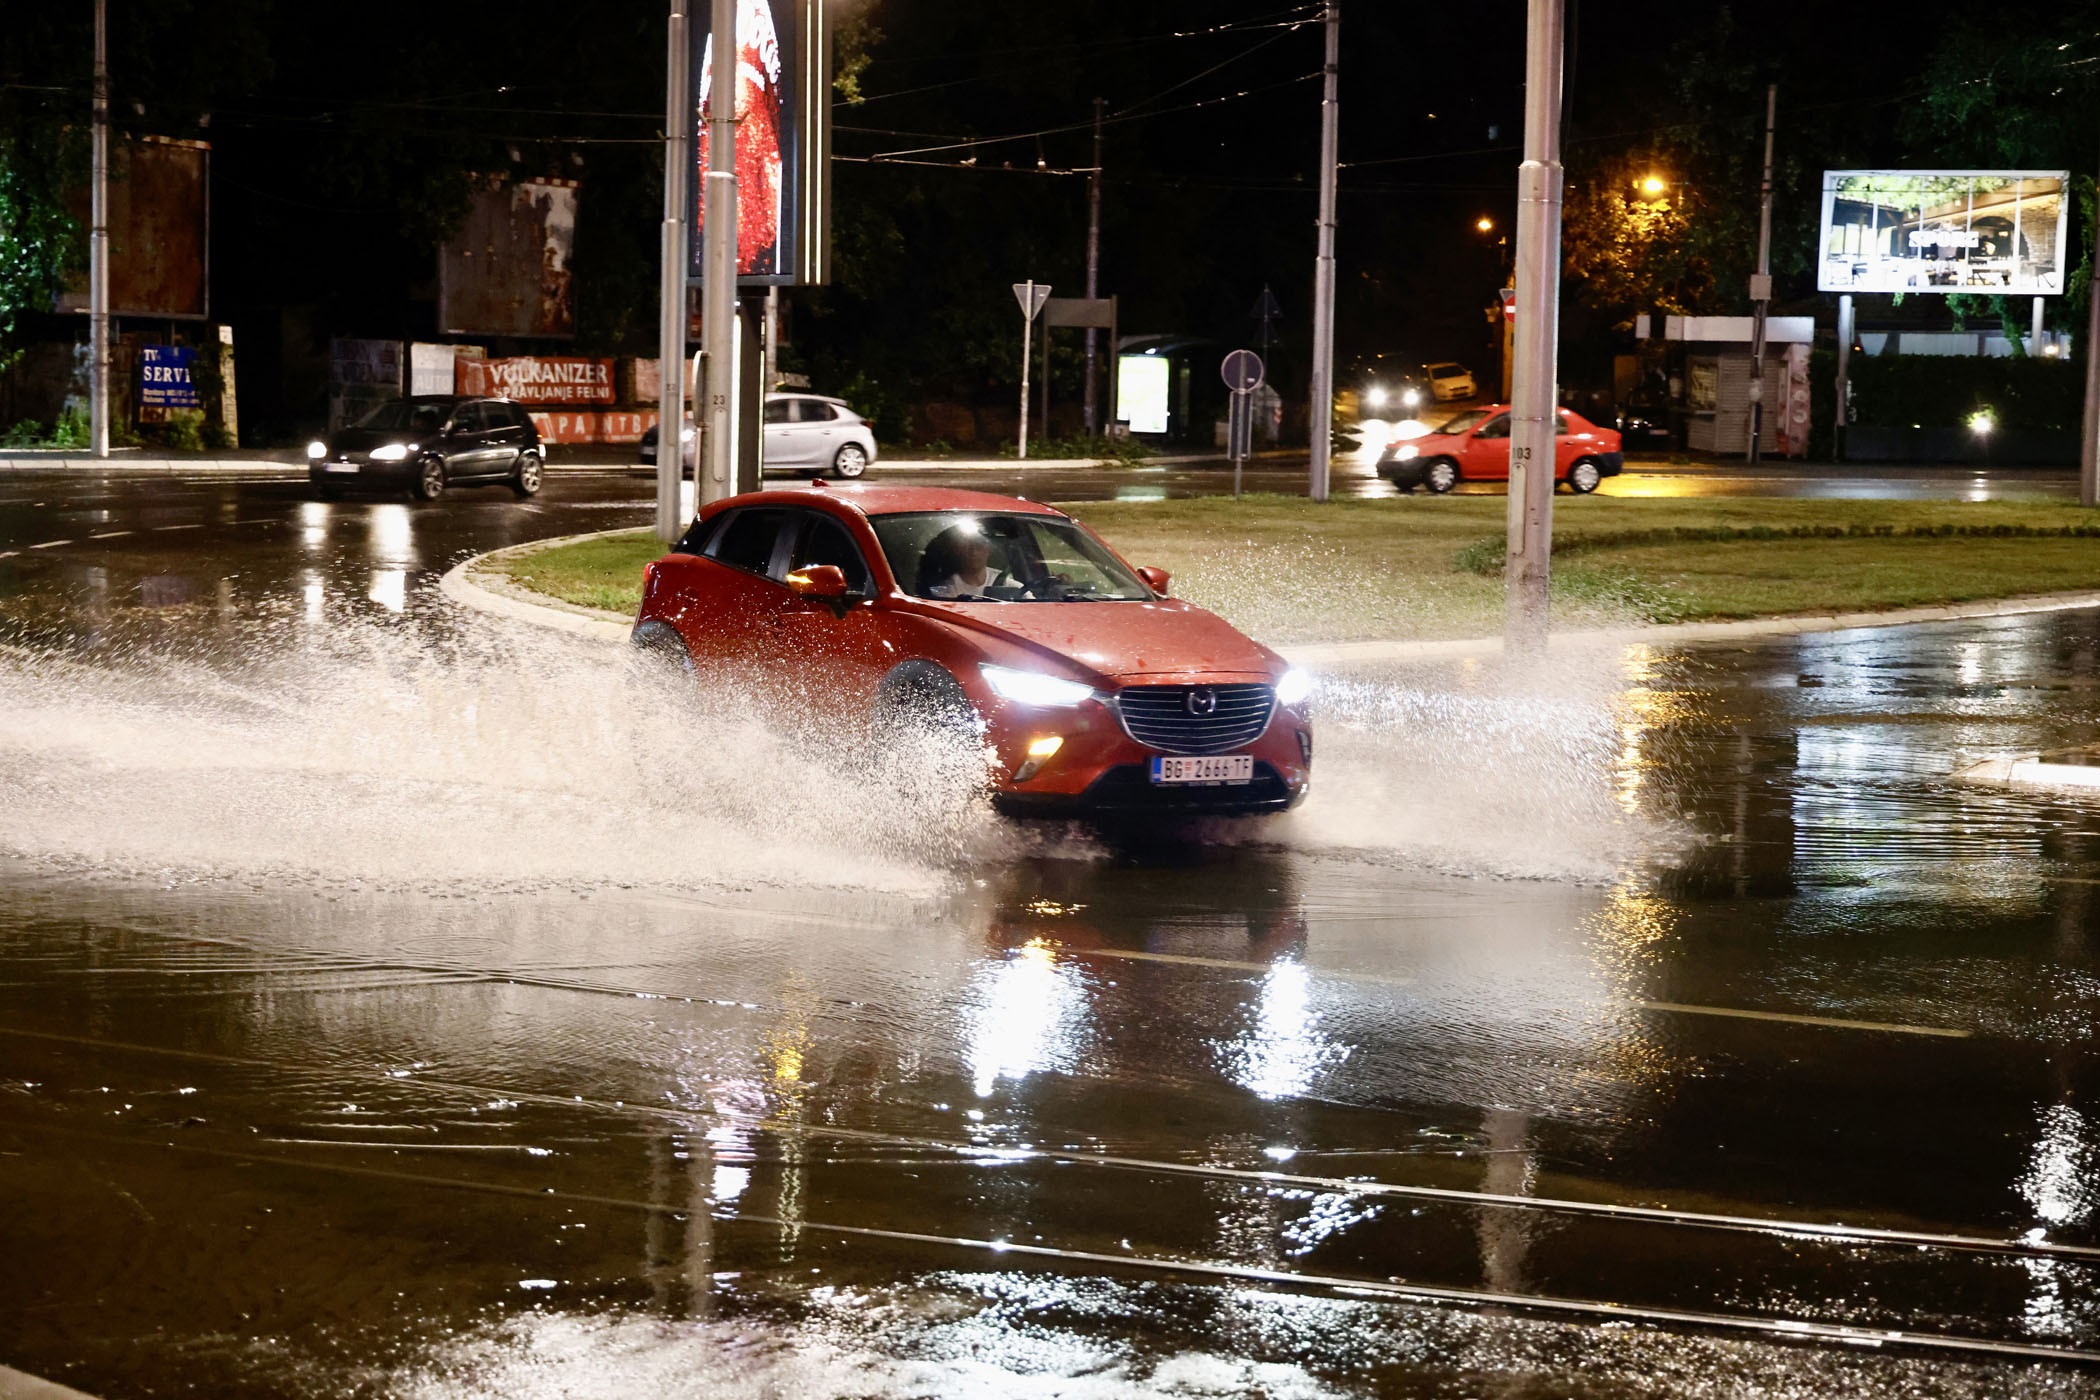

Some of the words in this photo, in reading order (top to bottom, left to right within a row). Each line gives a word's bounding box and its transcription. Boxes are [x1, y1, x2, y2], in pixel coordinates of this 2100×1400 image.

[143, 366, 191, 383] SERVI
[489, 363, 608, 384] VULKANIZER
[415, 374, 451, 391] AUTO
[577, 386, 609, 399] FELNI
[713, 394, 726, 405] 23
[559, 415, 659, 433] PAINTBA
[1513, 447, 1531, 460] 103
[1165, 760, 1183, 778] BG
